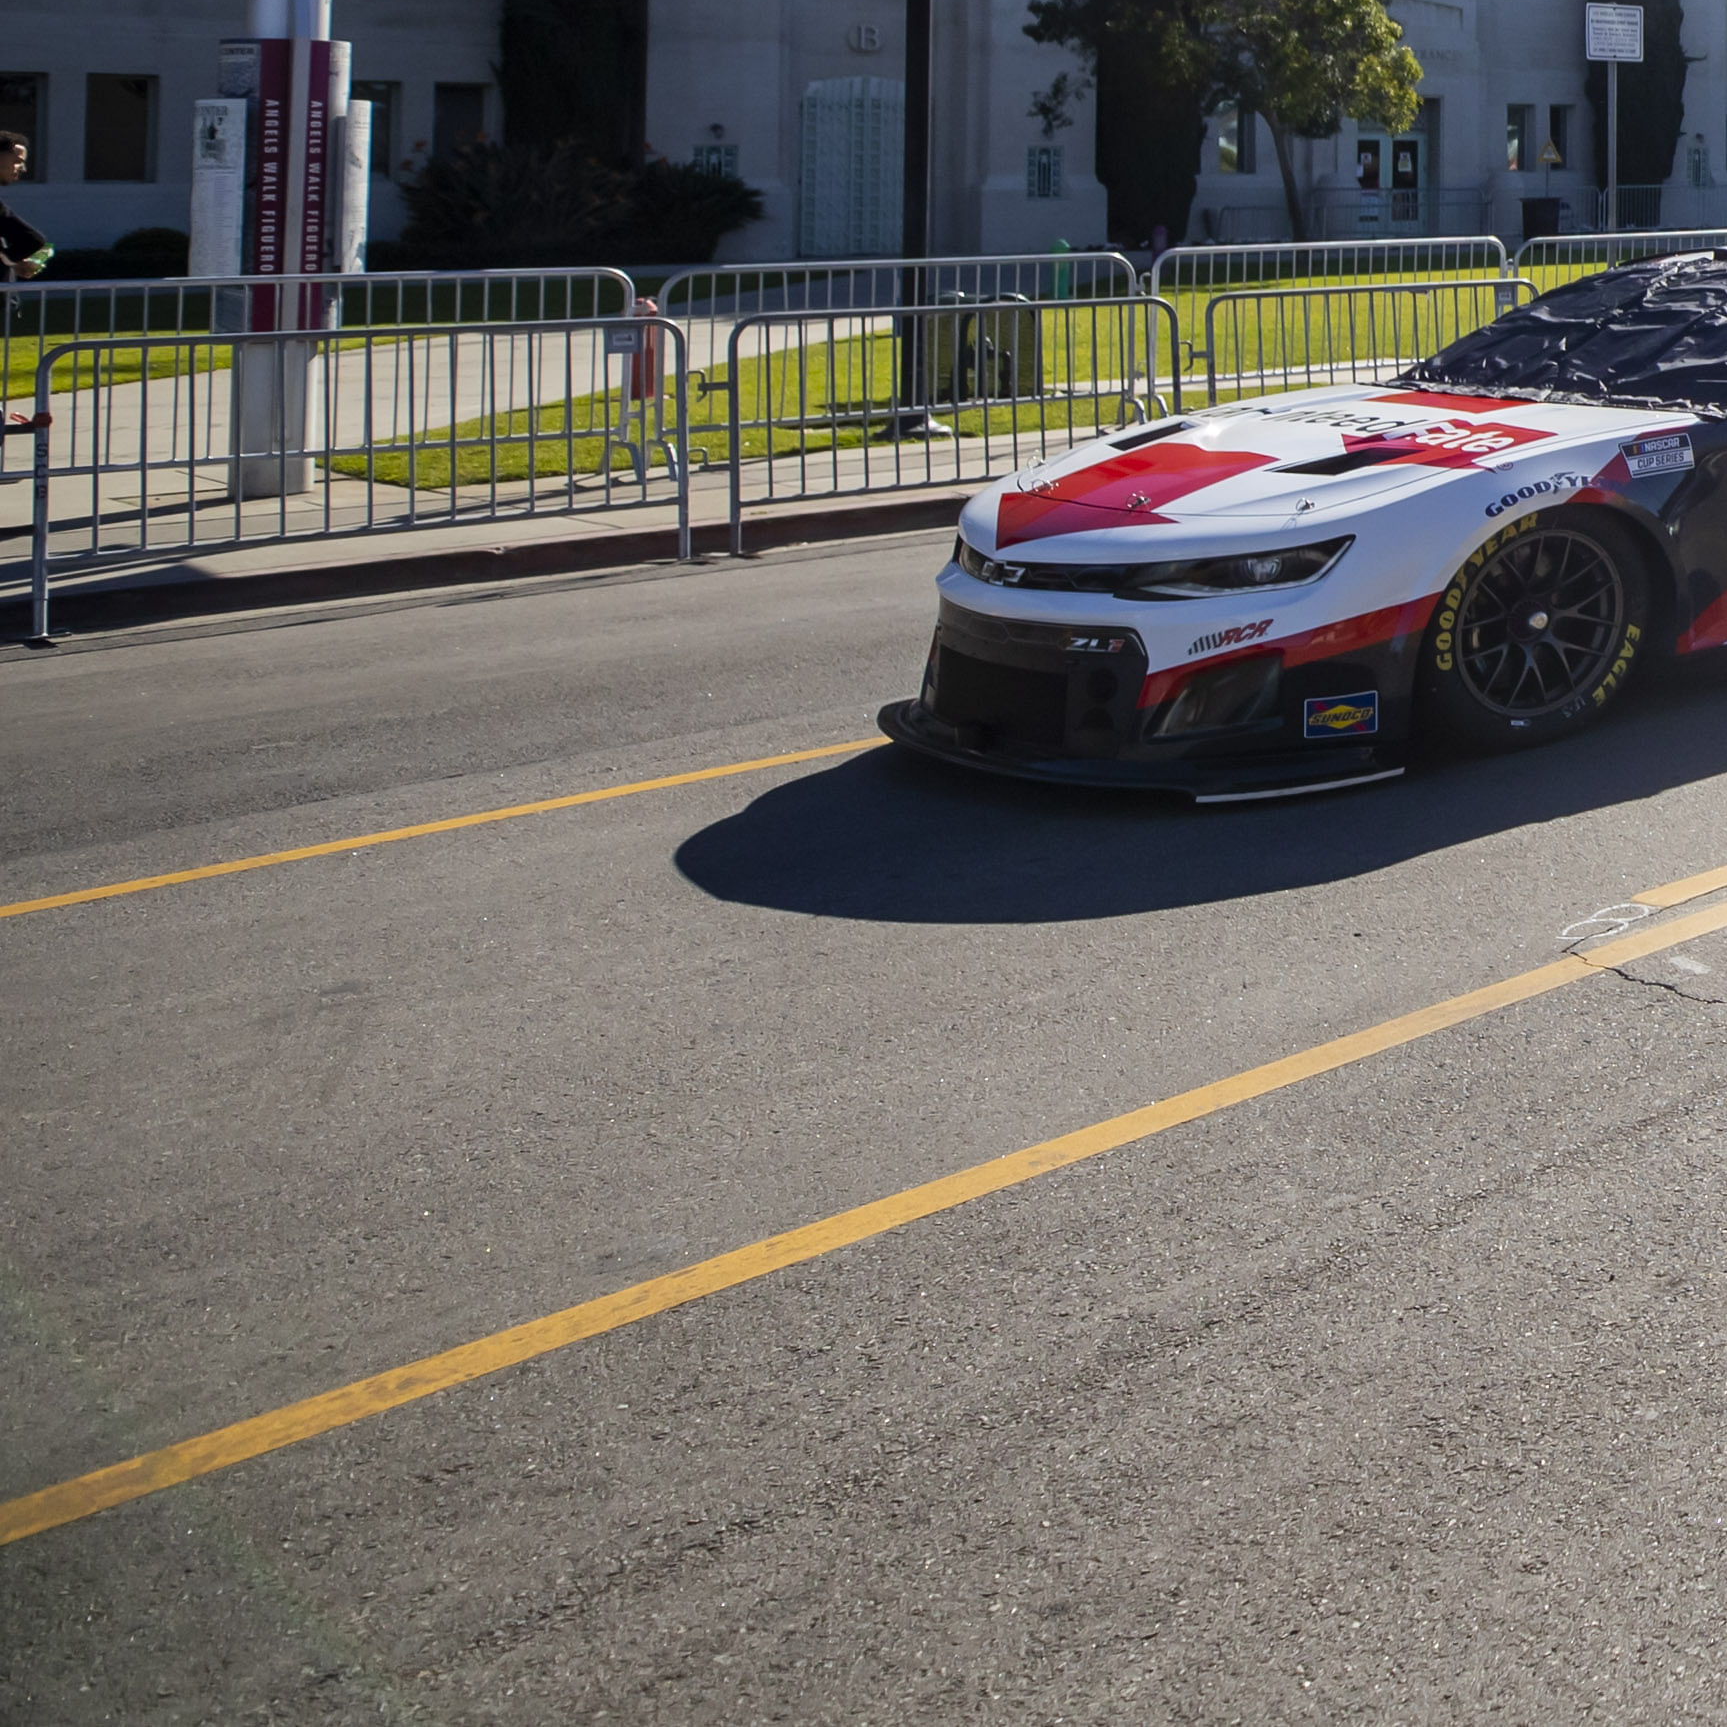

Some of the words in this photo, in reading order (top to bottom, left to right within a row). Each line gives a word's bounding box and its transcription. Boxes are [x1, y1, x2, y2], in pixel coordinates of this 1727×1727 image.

[857, 25, 881, 51] B
[263, 99, 280, 154] ANGELS
[308, 100, 324, 154] ANGELS
[262, 161, 278, 202] WALK
[307, 162, 321, 202] WALK
[260, 210, 276, 272] FIGUERO
[304, 209, 319, 272] FIGUERO
[1637, 455, 1655, 469] CUP
[1655, 451, 1685, 467] SERIES
[1643, 437, 1681, 453] NASCAR
[1436, 512, 1540, 672] GOODYEAR
[1065, 636, 1126, 654] ZL1
[1592, 623, 1642, 707] EAGLE
[1309, 707, 1374, 725] SUNOCO
